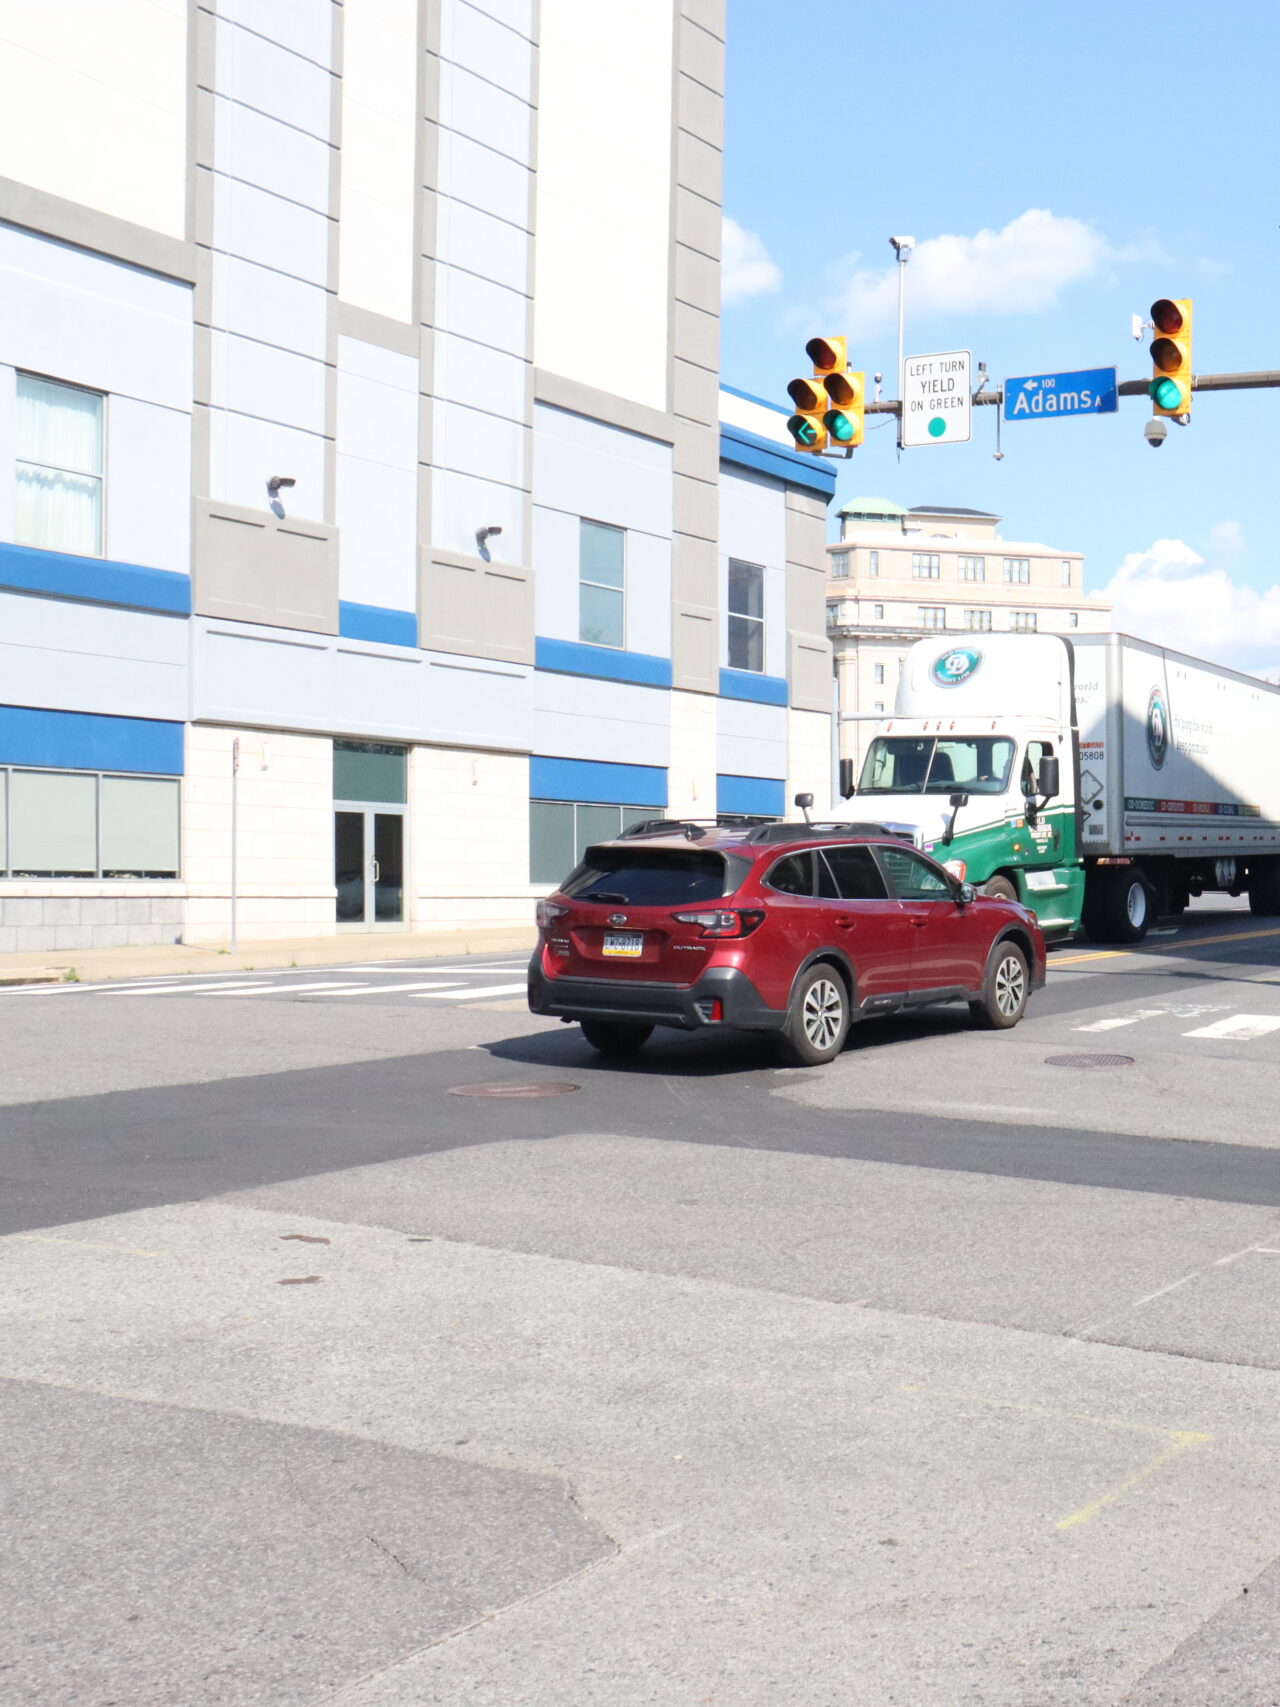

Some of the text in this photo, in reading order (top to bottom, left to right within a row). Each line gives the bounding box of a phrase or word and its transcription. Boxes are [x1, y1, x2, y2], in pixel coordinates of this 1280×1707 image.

[910, 360, 965, 376] LEFT TURN
[921, 378, 955, 394] YIELD
[1042, 378, 1055, 388] 100
[911, 396, 963, 412] ON GREEN
[1013, 390, 1091, 415] Adams
